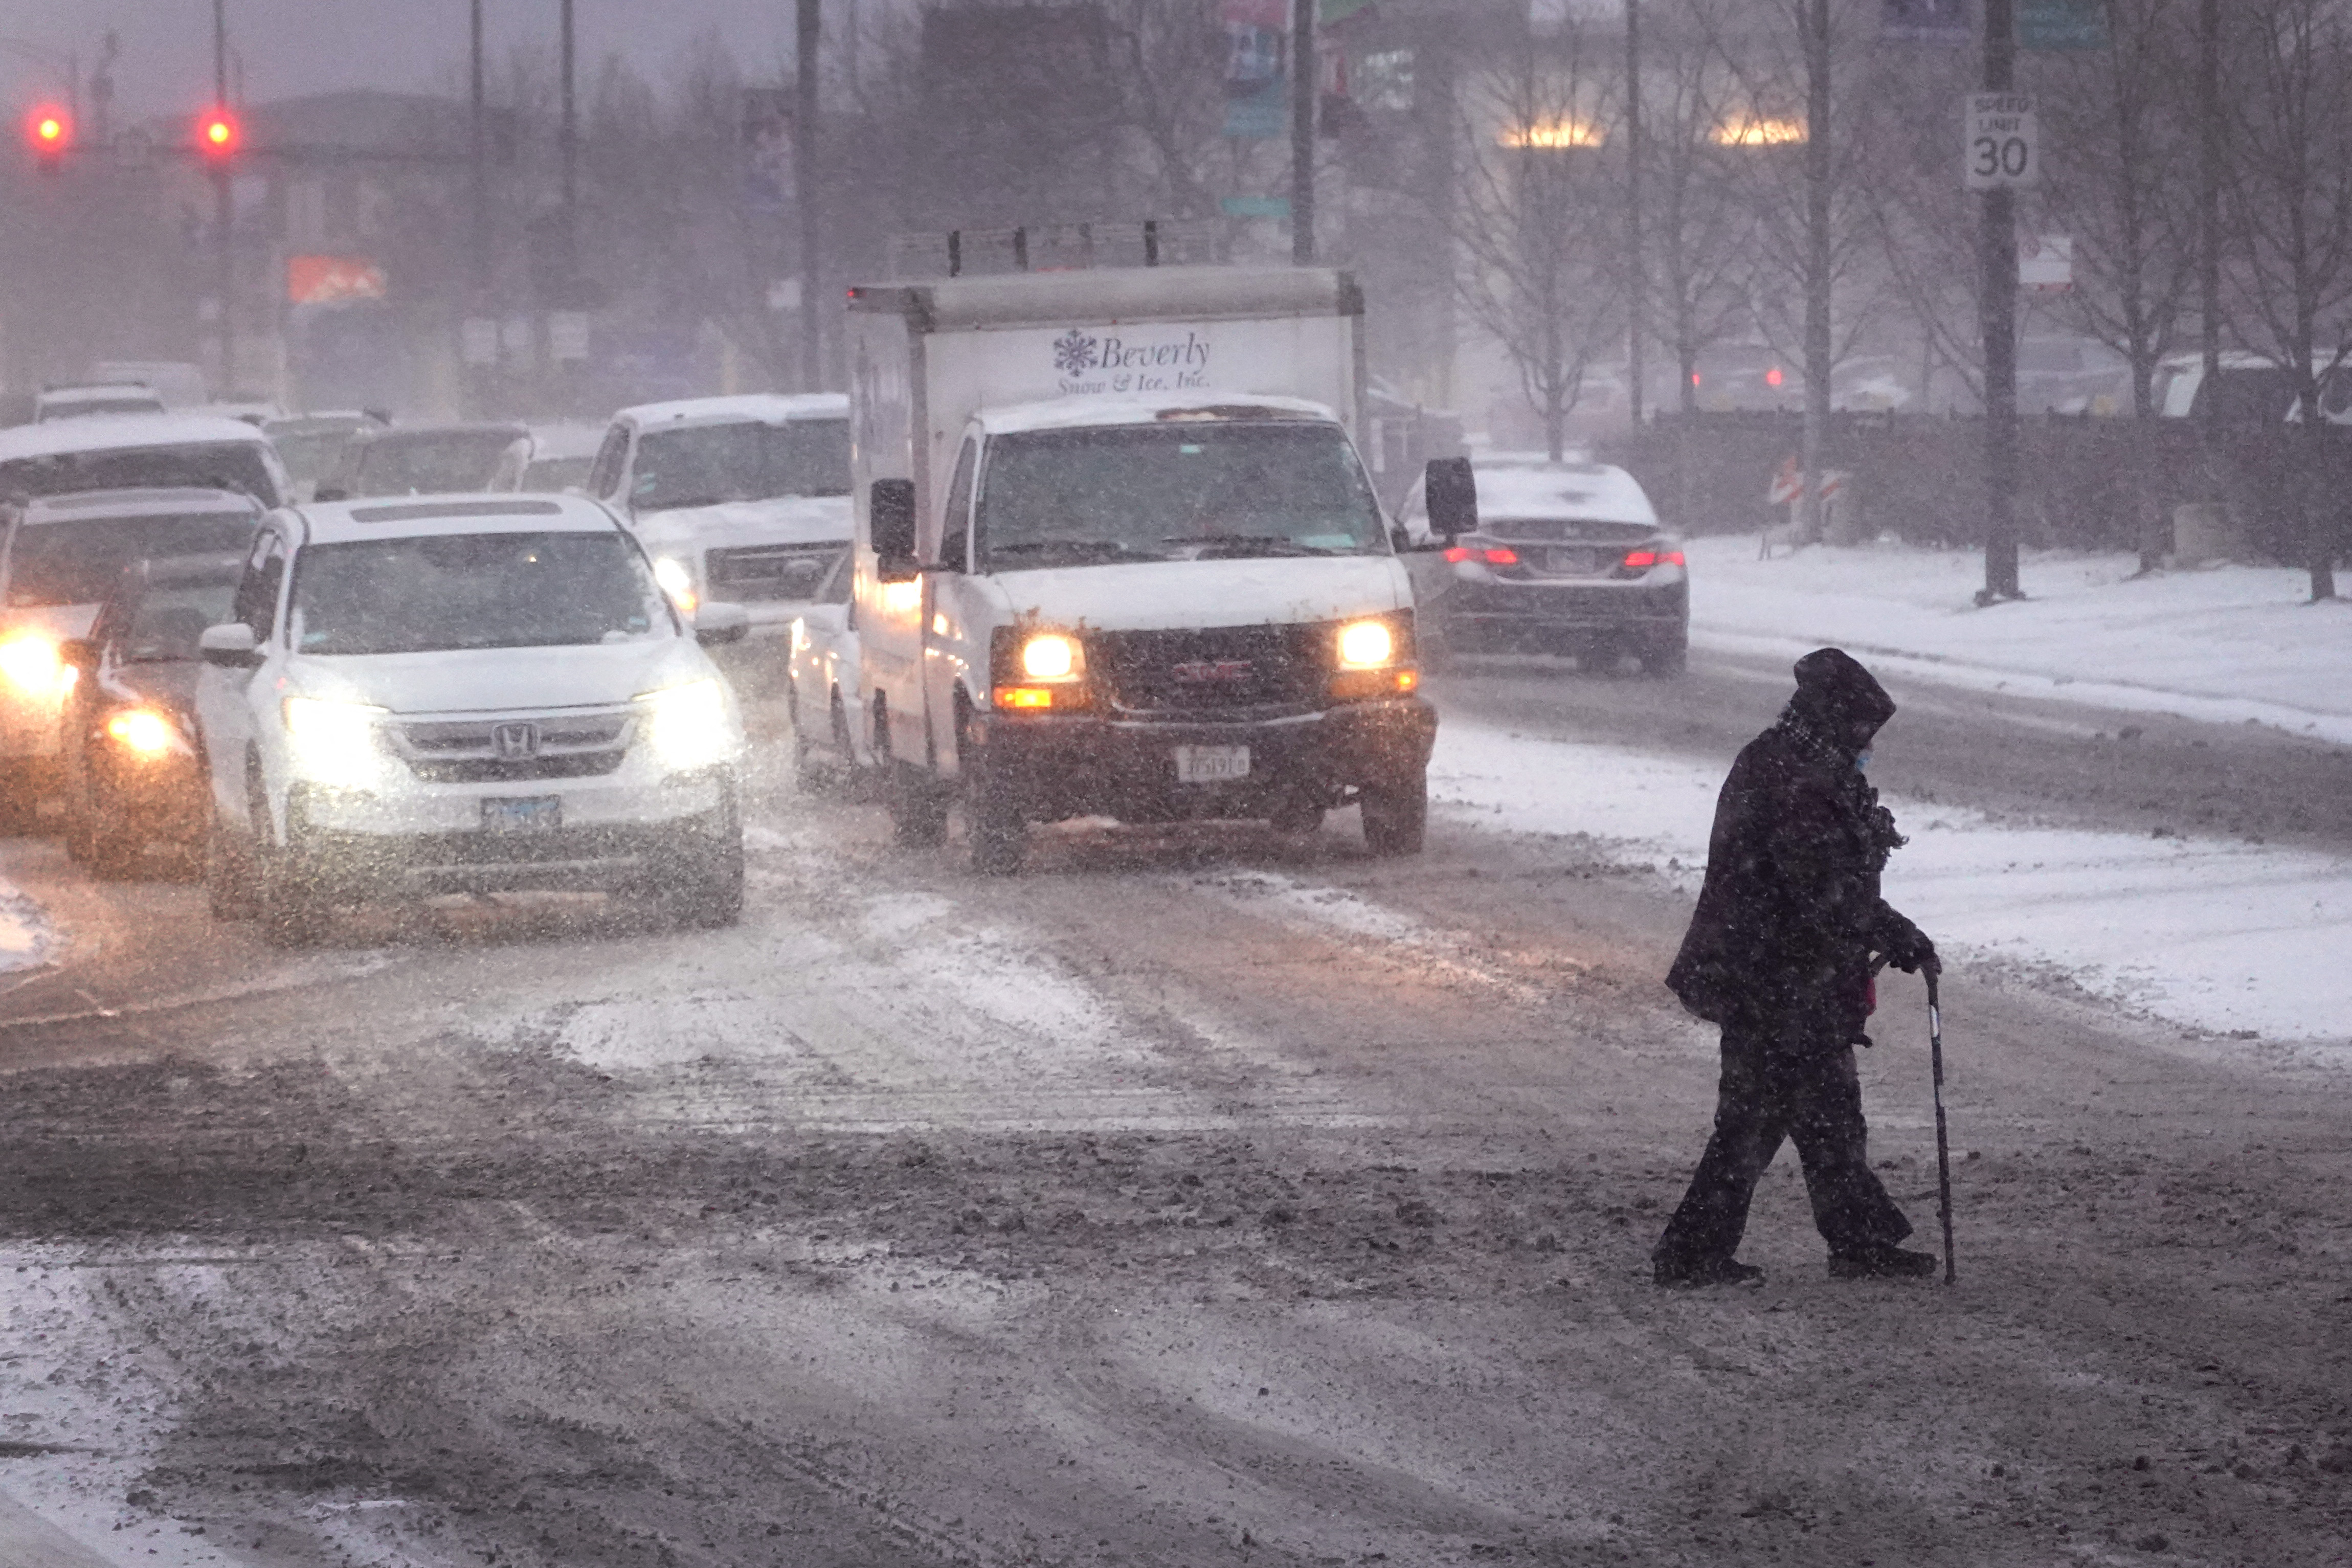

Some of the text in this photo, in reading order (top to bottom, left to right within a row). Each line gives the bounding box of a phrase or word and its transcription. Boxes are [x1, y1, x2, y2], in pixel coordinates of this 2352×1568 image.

[1975, 96, 2032, 114] SPEED
[1978, 117, 2022, 132] LIMIT
[1974, 136, 2028, 177] 30
[1101, 332, 1210, 375] Beverly
[1058, 377, 1106, 394] Snow
[1112, 373, 1132, 392] &
[1176, 371, 1211, 389] Inc.
